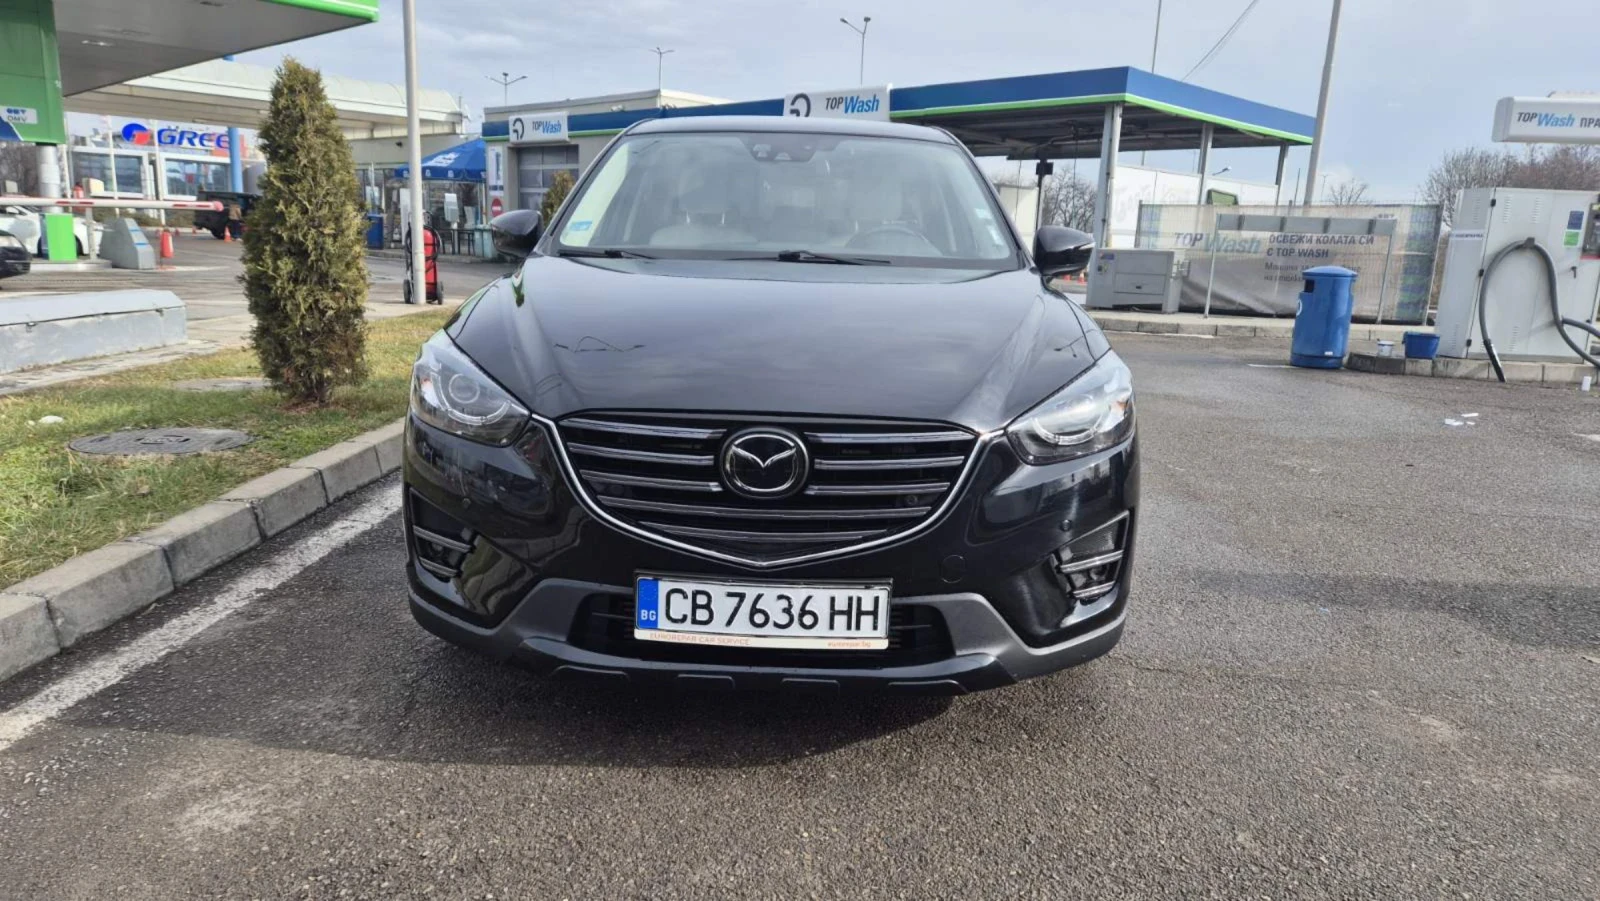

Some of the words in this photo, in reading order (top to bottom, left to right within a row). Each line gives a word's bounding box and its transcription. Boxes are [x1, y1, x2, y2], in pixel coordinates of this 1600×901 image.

[157, 128, 230, 149] GREE
[1268, 234, 1313, 245] ОСВЕЖИ
[1315, 235, 1356, 245] КОЛАТА
[1358, 236, 1375, 246] СИ
[1298, 248, 1329, 259] WASH
[640, 609, 657, 620] BG
[665, 588, 714, 626] CB
[725, 591, 819, 630] 7636
[829, 595, 880, 631] HH
[698, 635, 715, 643] CAR
[716, 637, 751, 646] SERVICE
